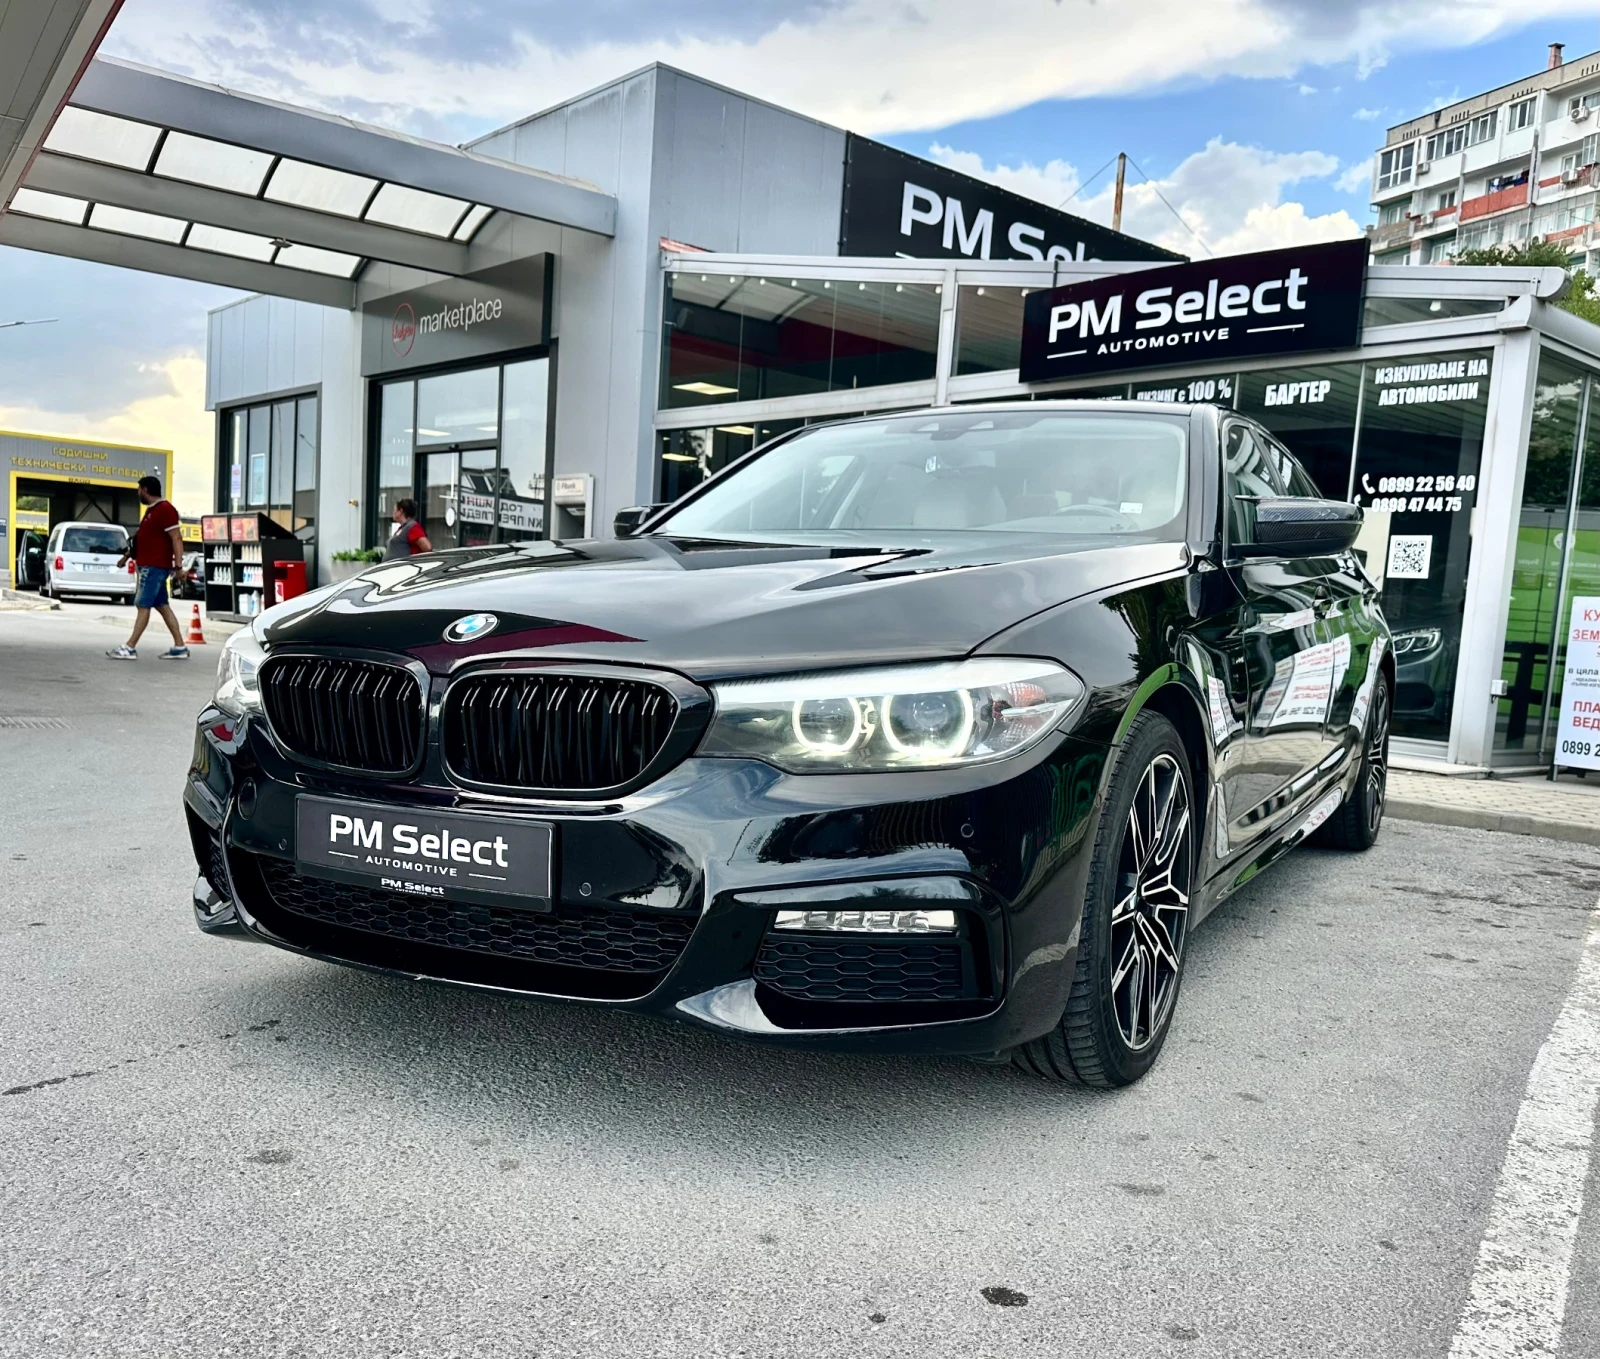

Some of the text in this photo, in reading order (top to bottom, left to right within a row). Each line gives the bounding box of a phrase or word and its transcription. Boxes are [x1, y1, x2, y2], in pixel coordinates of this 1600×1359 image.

[900, 181, 994, 261] PM
[420, 297, 502, 335] marketplace
[1048, 268, 1308, 343] PM Select
[1097, 328, 1230, 355] AUTOMOTIVE
[1375, 358, 1488, 384] ИЗКУПУВАНЕ НА
[1187, 380, 1216, 402] 100
[1218, 378, 1232, 399] %
[1264, 380, 1331, 406] БАРТЕР
[1378, 382, 1479, 406] АВТОМОБИЛИ
[10, 456, 87, 472] ТЕХНИЧЕСКИ
[1378, 475, 1476, 493] 0899 22 56 40
[1371, 496, 1462, 512] 0898 47 44 75
[1573, 701, 1600, 713] ПЛА
[1562, 740, 1591, 756] 0899
[330, 813, 509, 868] PM Select
[365, 855, 458, 877] AUTOMOTIVE
[381, 877, 402, 888] PM
[404, 882, 444, 895] Select
